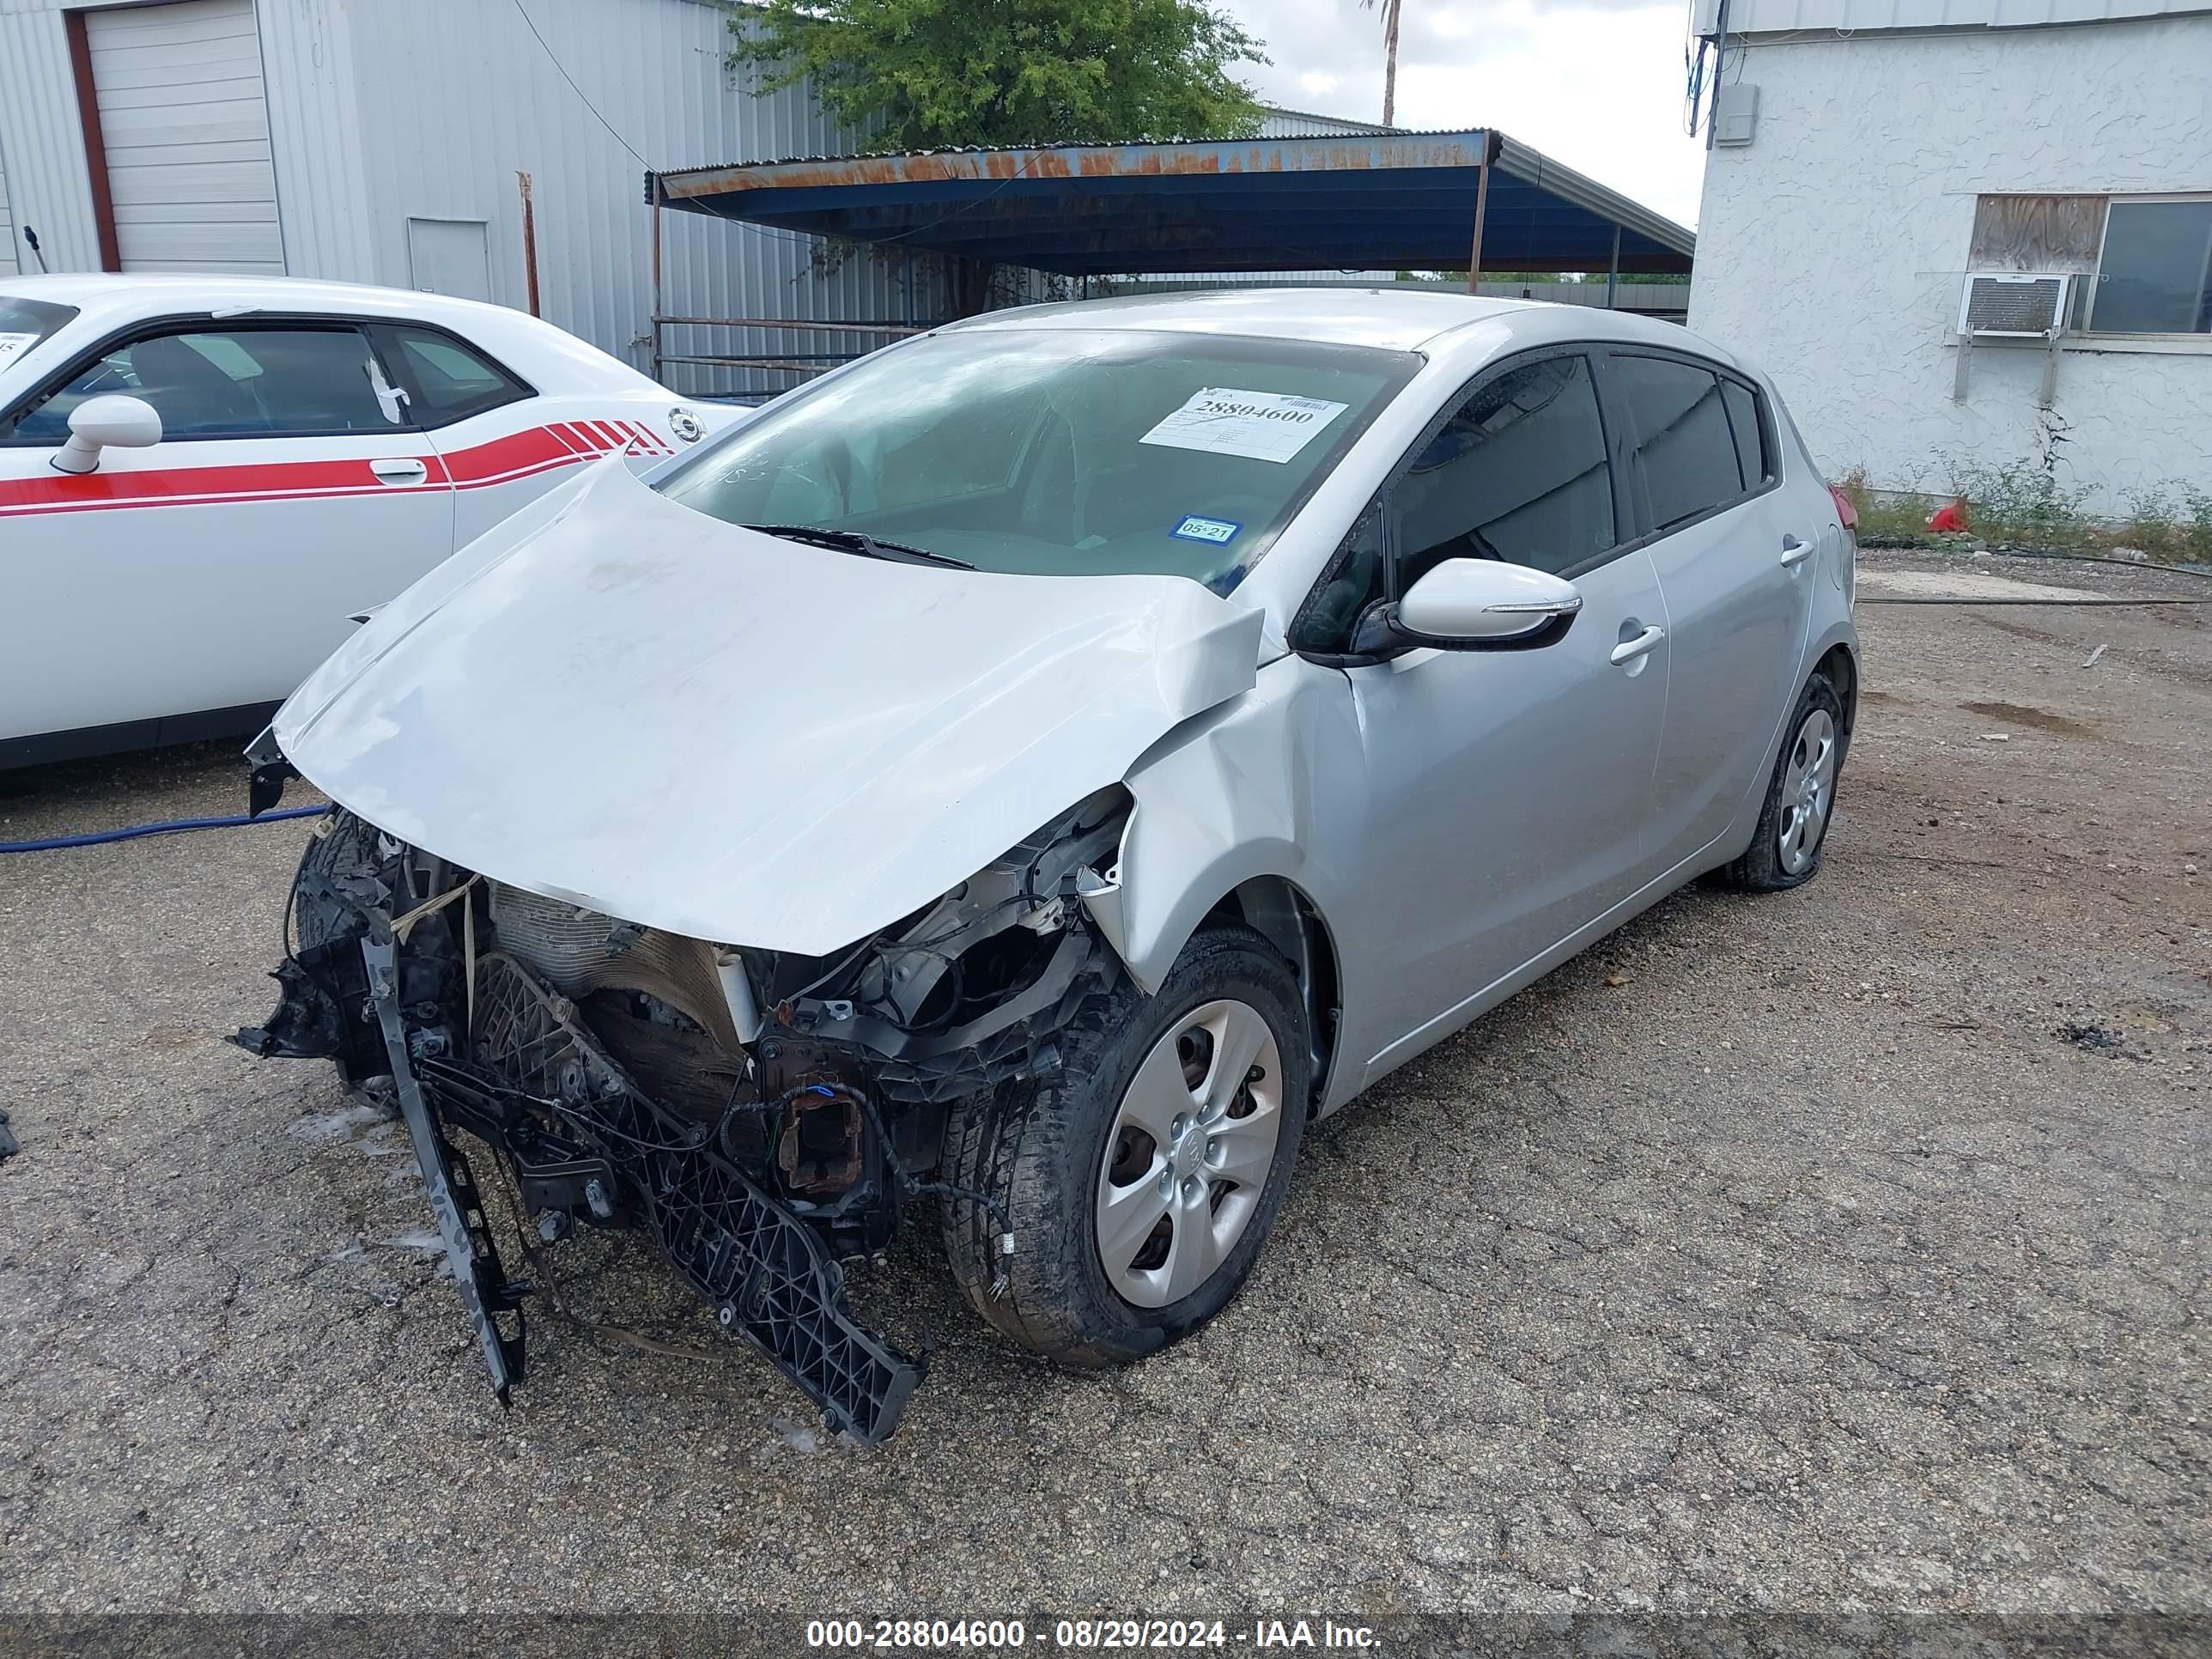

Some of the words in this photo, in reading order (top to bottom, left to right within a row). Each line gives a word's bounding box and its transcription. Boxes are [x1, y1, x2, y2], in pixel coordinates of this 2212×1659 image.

[1194, 399, 1314, 424] 28804600
[1182, 523, 1203, 533] 05
[1206, 527, 1228, 538] 21
